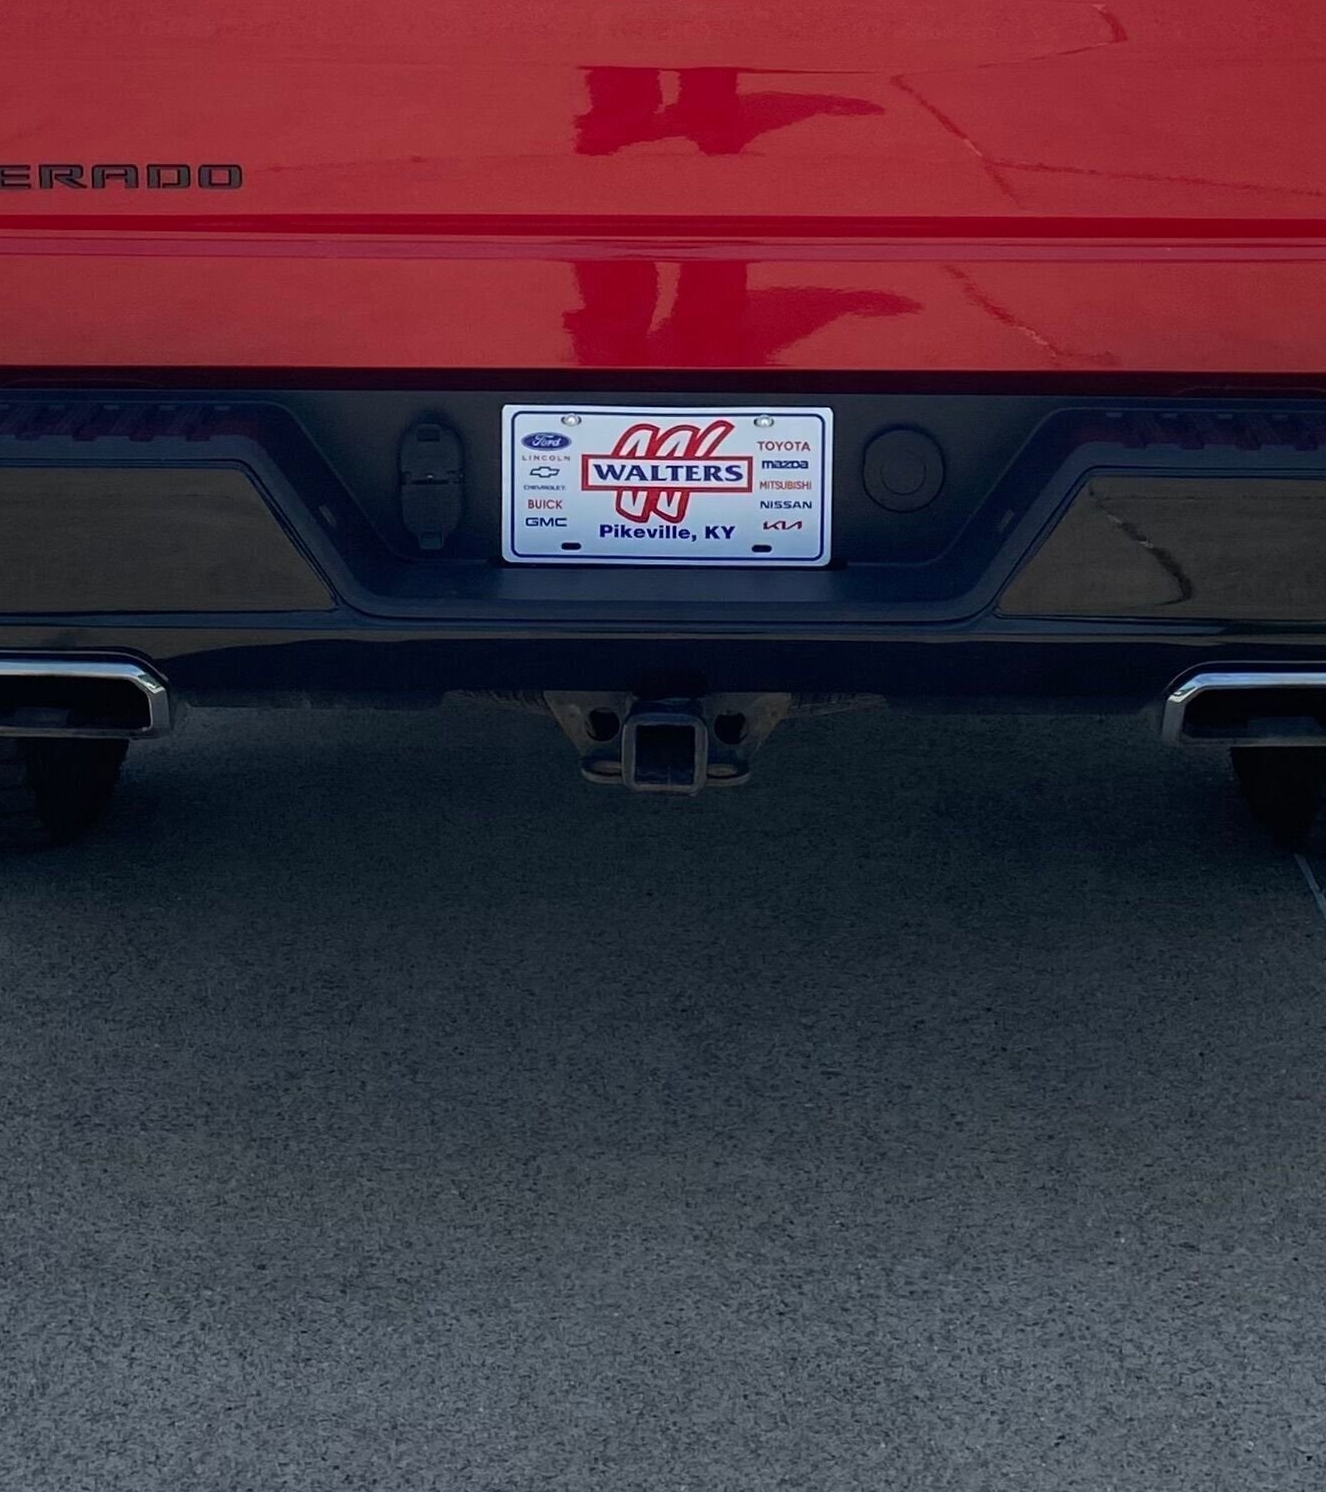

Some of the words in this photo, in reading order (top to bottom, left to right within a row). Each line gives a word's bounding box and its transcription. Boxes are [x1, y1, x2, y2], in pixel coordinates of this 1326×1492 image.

[532, 434, 562, 447] Ford
[757, 440, 811, 452] TOYOTA
[521, 454, 571, 462] LINCOLN
[592, 464, 744, 483] WALTERS
[759, 480, 812, 491] MITSUBISHI
[527, 499, 563, 510] BUICK
[760, 500, 812, 510] NISSAN
[525, 516, 568, 528] GMC
[762, 520, 803, 531] KIA
[599, 524, 697, 542] Pikeville,
[704, 525, 736, 540] KY
